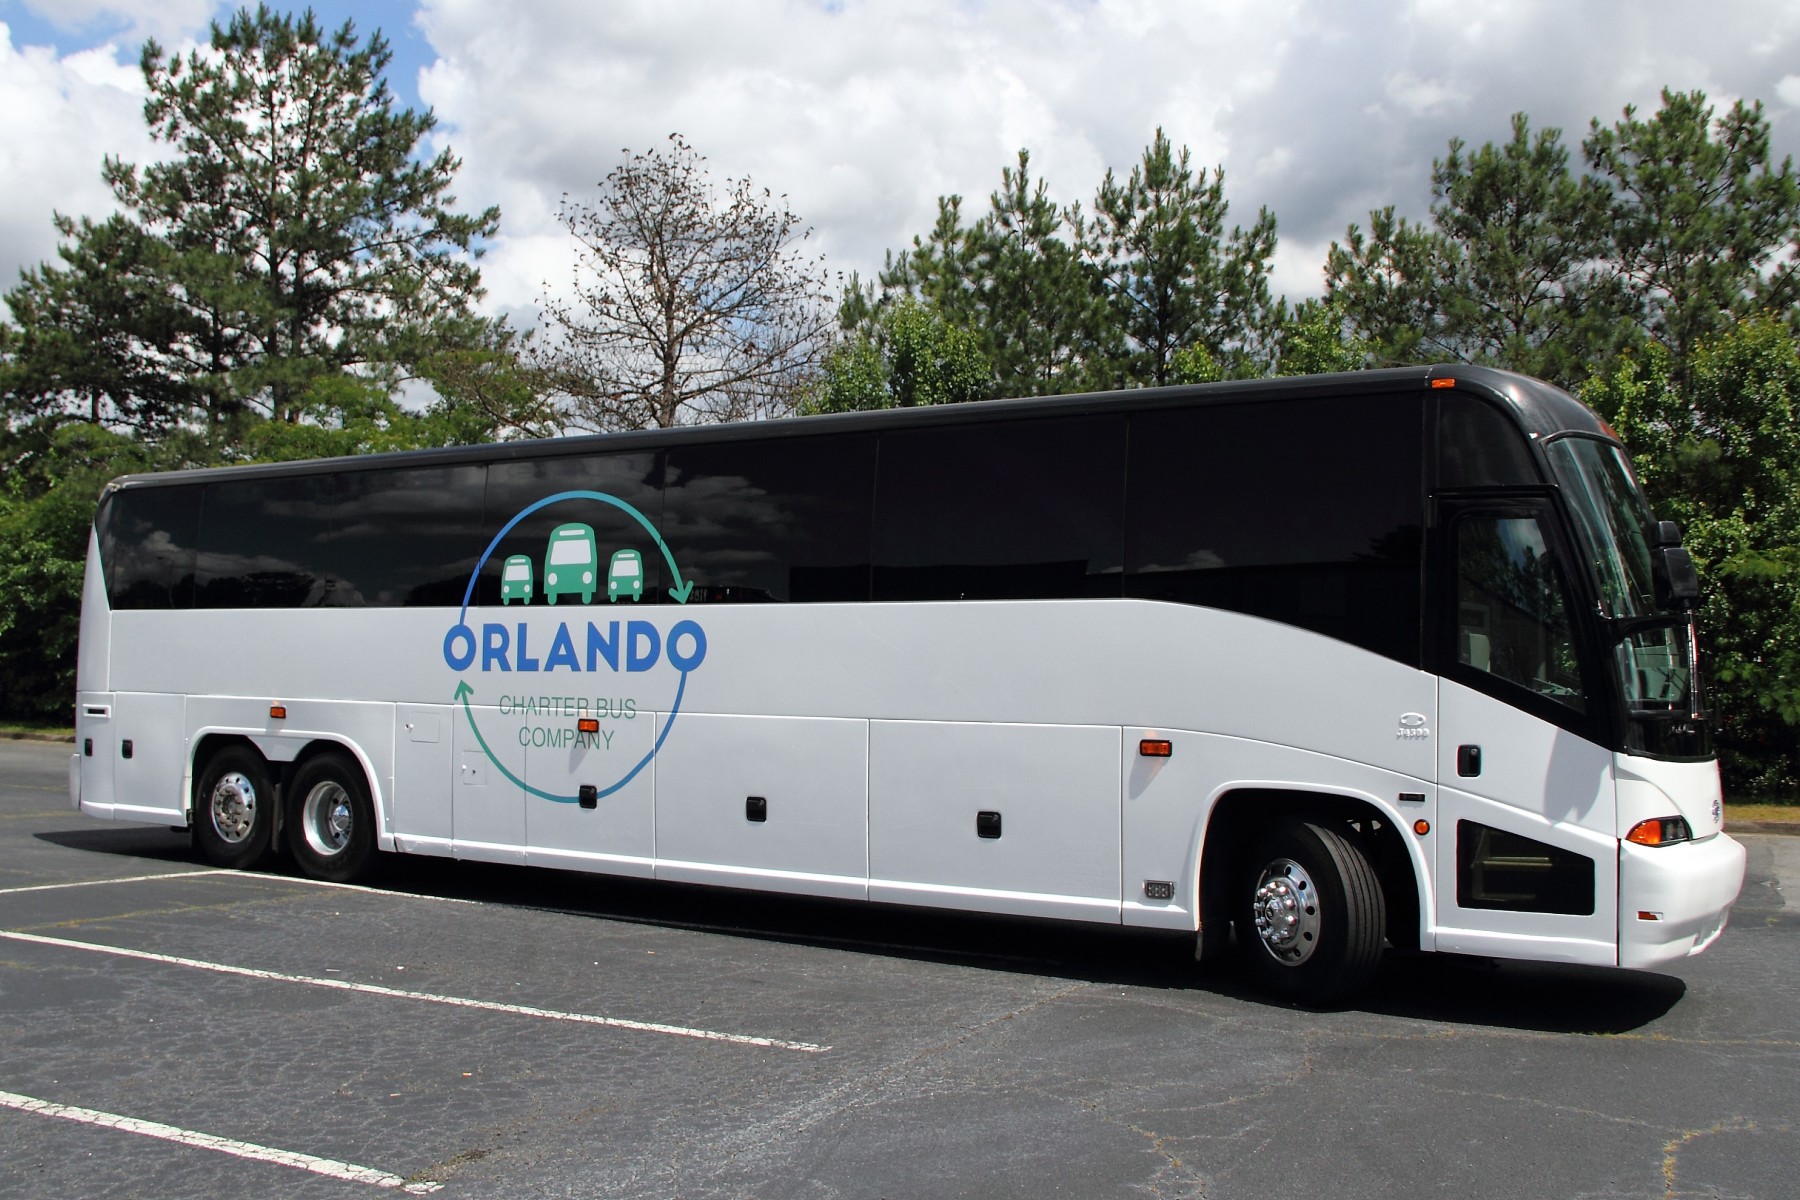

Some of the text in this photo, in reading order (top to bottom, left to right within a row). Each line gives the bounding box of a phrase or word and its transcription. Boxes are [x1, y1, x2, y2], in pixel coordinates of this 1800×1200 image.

[443, 620, 707, 672] ORLANDO
[500, 695, 636, 719] CHARTER BUS
[519, 727, 614, 750] COMPANY
